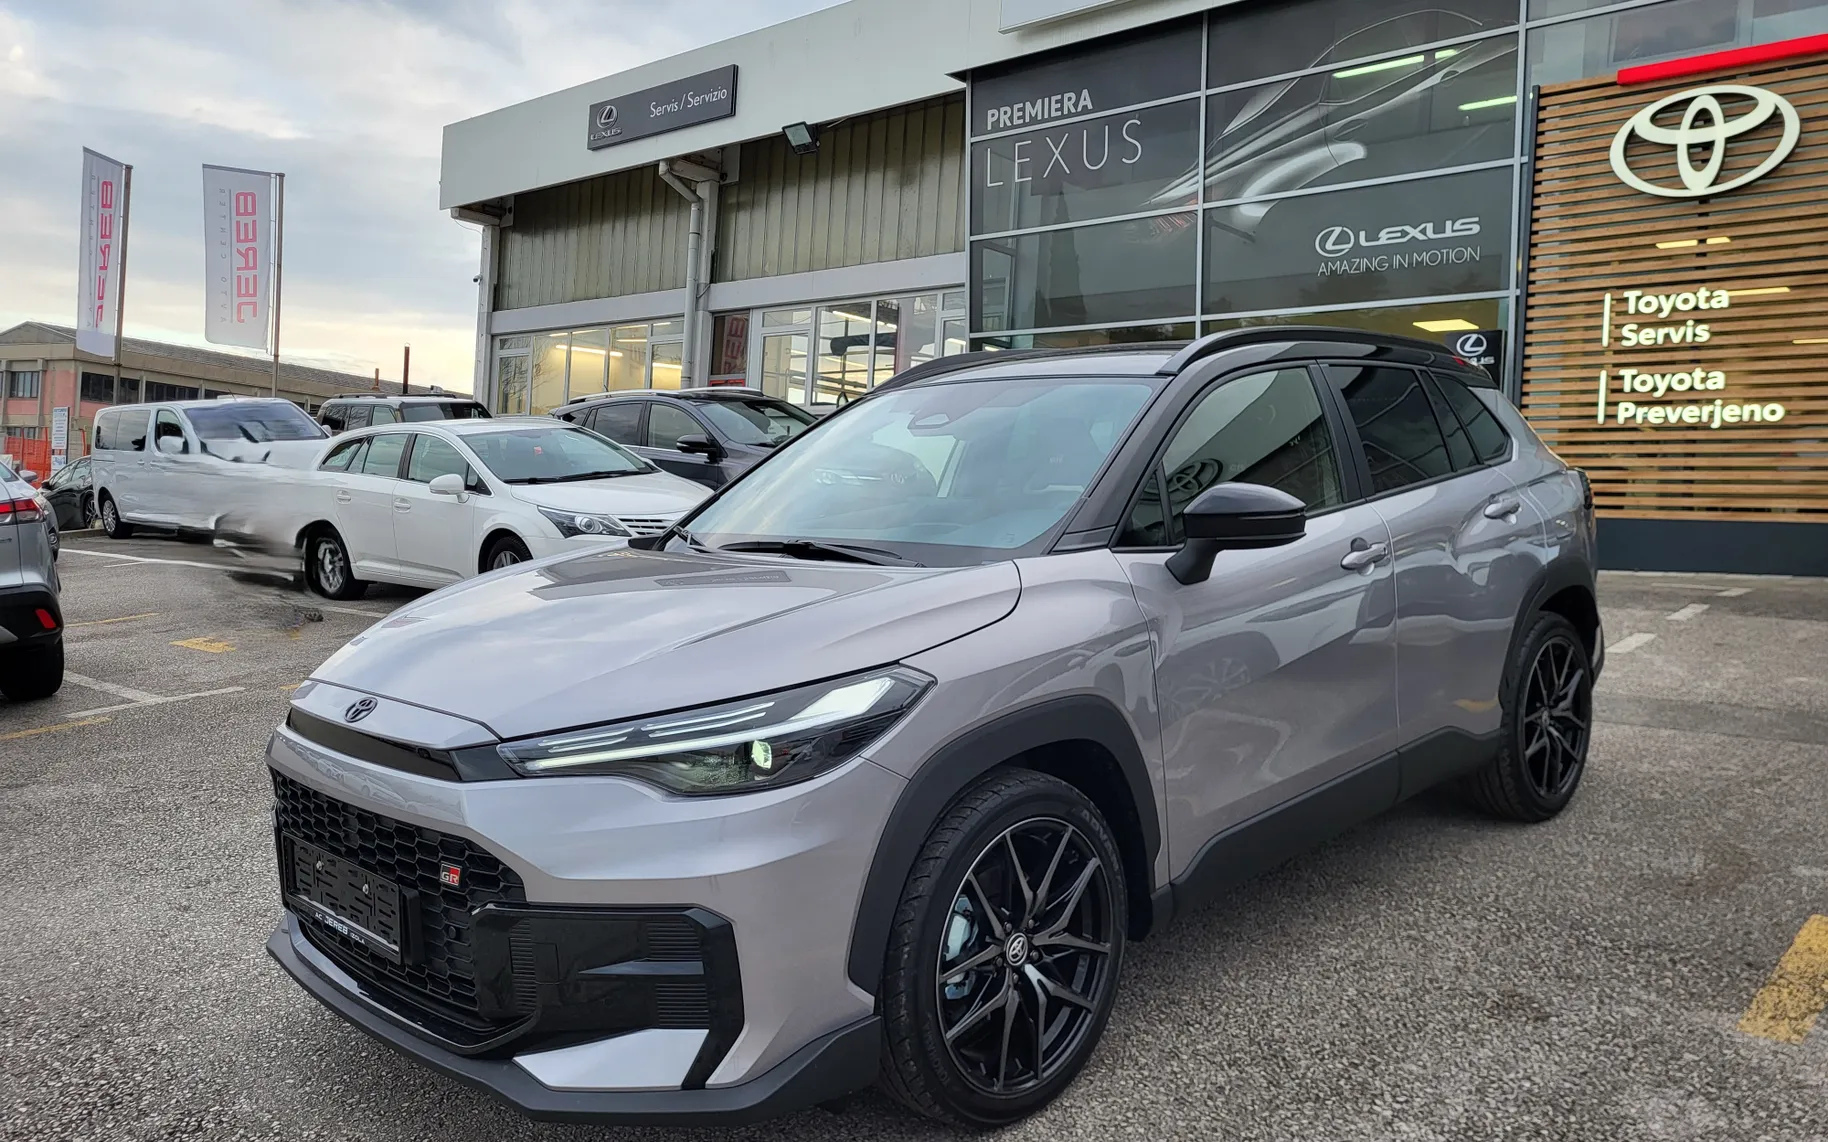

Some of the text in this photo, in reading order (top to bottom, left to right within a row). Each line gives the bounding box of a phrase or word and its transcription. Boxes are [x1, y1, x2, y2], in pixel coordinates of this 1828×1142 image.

[650, 99, 679, 118] Servis
[687, 86, 728, 108] Servizio
[986, 88, 1093, 131] PREMIERA
[590, 127, 622, 141] LEXUS
[986, 119, 1142, 188] LEXUS
[1359, 217, 1481, 247] LEXUS
[1317, 246, 1480, 277] AMAZING IN MOTION
[1622, 286, 1730, 319] Toyota
[1620, 319, 1711, 347] Servis
[1618, 367, 1726, 398] Toyota
[1616, 399, 1786, 429] Preverjeno
[441, 871, 459, 884] GR
[324, 915, 349, 935] JEREB
